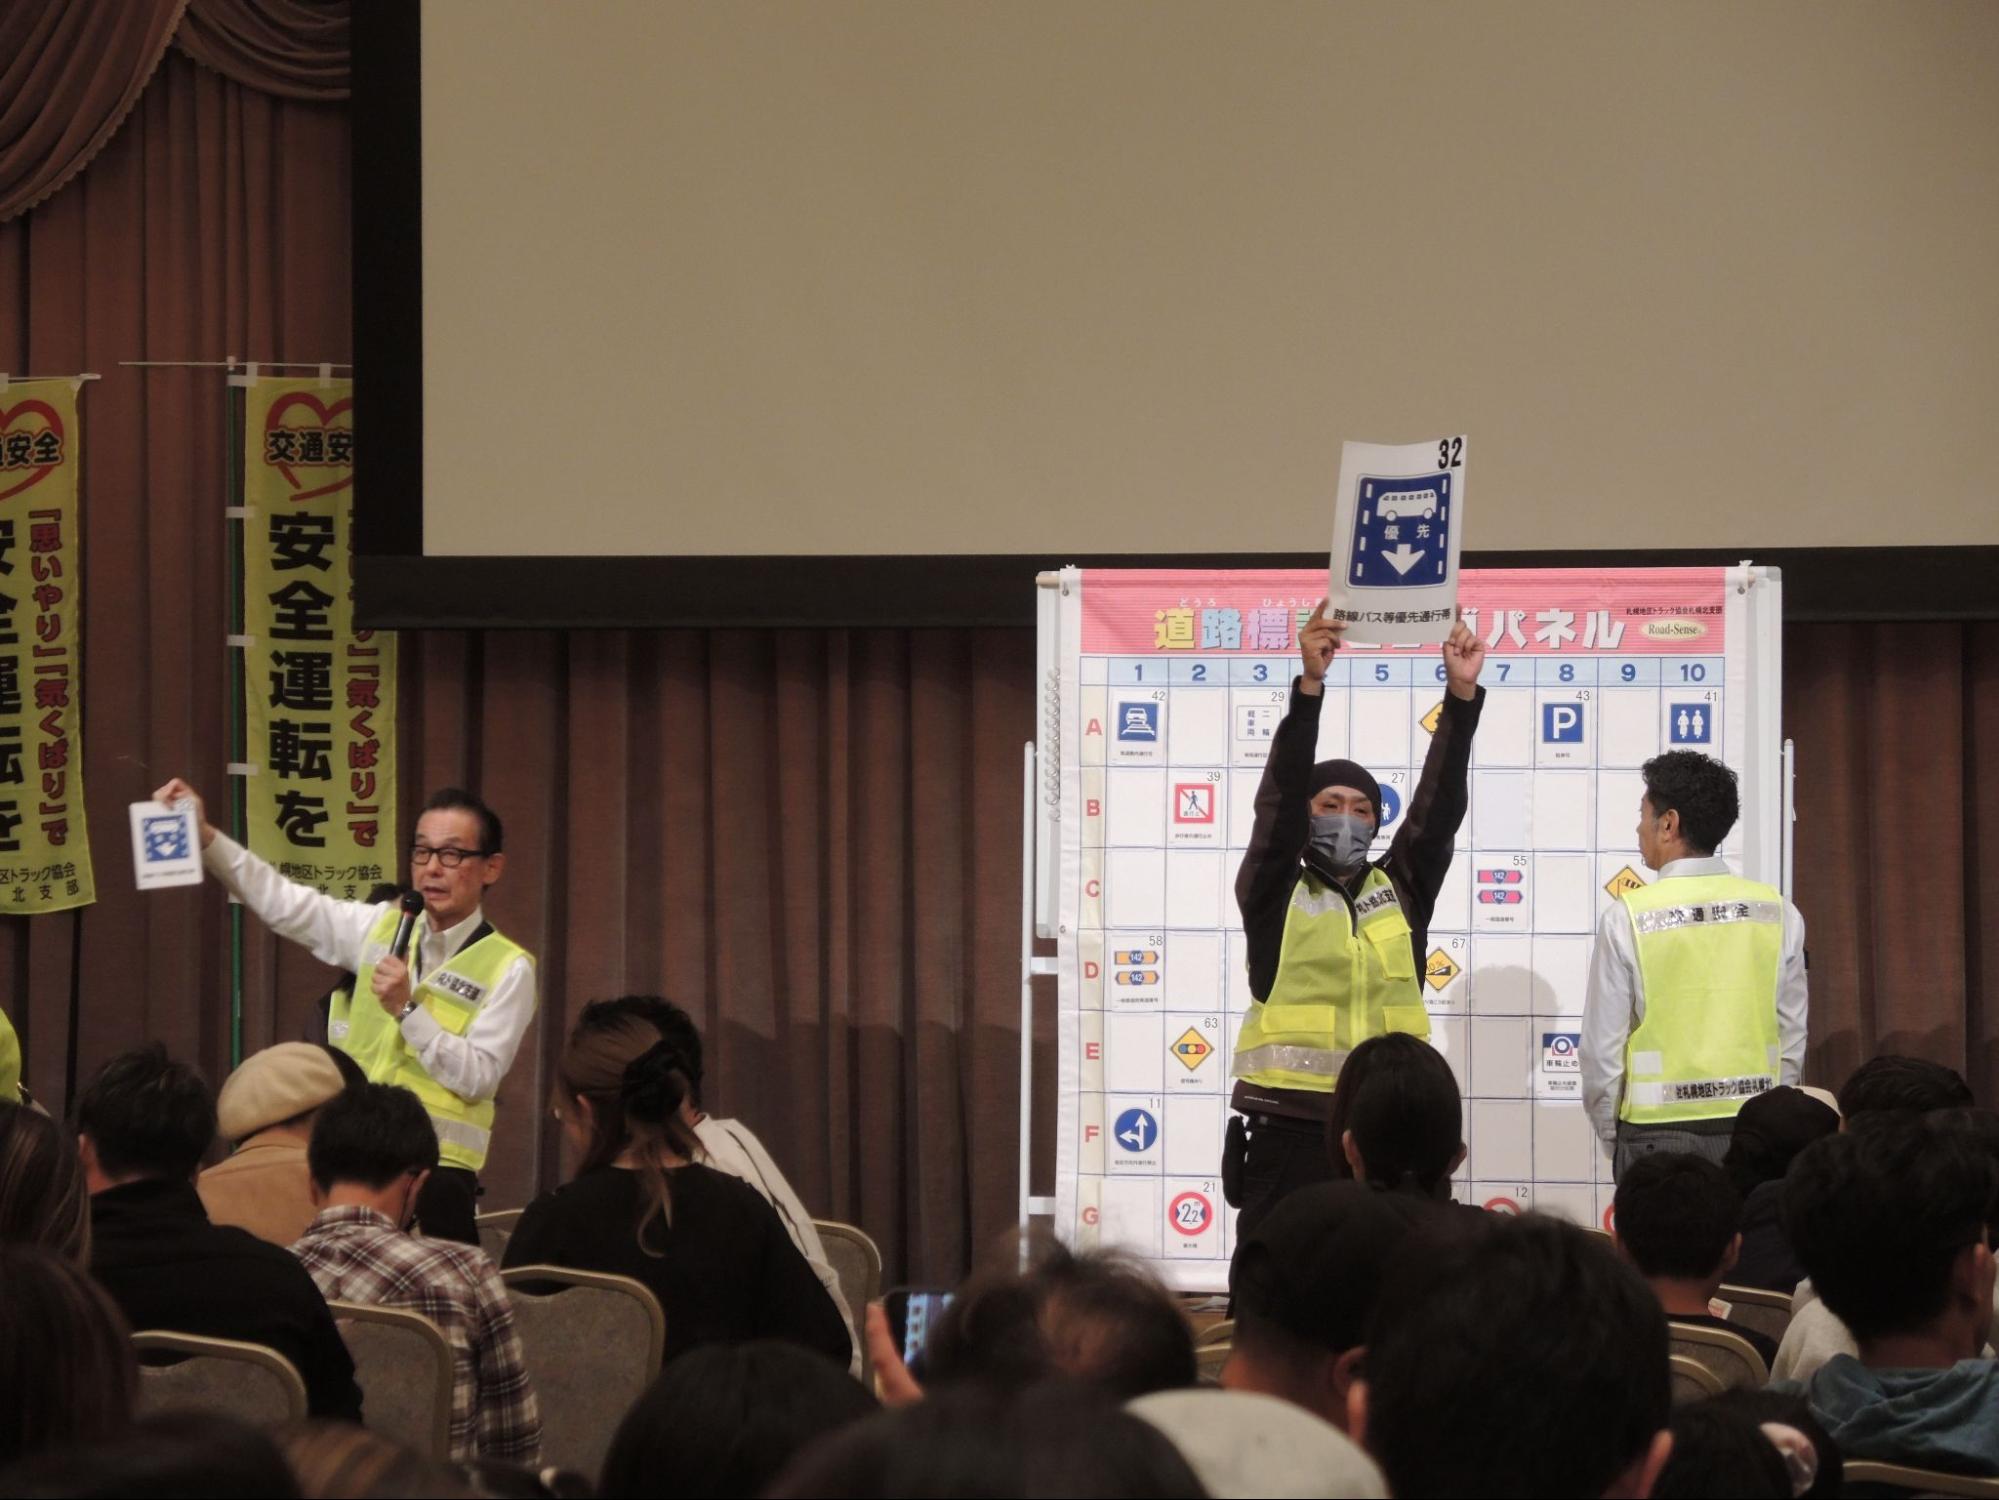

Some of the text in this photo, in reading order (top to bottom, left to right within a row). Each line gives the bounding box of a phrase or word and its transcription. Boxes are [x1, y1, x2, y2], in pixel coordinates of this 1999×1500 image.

[0, 433, 61, 467] 安全
[1438, 437, 1462, 469] 32
[1384, 524, 1430, 540] 優先
[1179, 598, 1216, 607] どうろ
[1334, 607, 1451, 624] 路線バス等優先通行帯
[268, 511, 335, 848] 安全運転を
[1135, 664, 1705, 682] 1 2 3 5 6 7 8 9 10
[1152, 691, 1165, 701] 42
[1271, 691, 1285, 702] 29
[1576, 690, 1590, 701] 43
[1704, 691, 1718, 702] 41
[1085, 719, 1103, 736] A
[1553, 707, 1577, 739] P
[1207, 771, 1221, 781] 39
[1391, 772, 1405, 783] 27
[1087, 800, 1100, 817] B
[1513, 855, 1527, 866] 55
[279, 863, 382, 882] 幌地区トラック協会
[12, 879, 80, 902] 北支部
[1086, 880, 1100, 897] C
[1149, 935, 1163, 946] 58
[1452, 938, 1466, 949] 67
[1085, 962, 1099, 979] D
[1204, 1017, 1218, 1028] 63
[1086, 1042, 1100, 1060] E
[1150, 1098, 1160, 1109] 11
[1085, 1125, 1099, 1142] F
[1203, 1182, 1215, 1192] 21
[1516, 1187, 1528, 1198] 12
[1082, 1207, 1099, 1225] G
